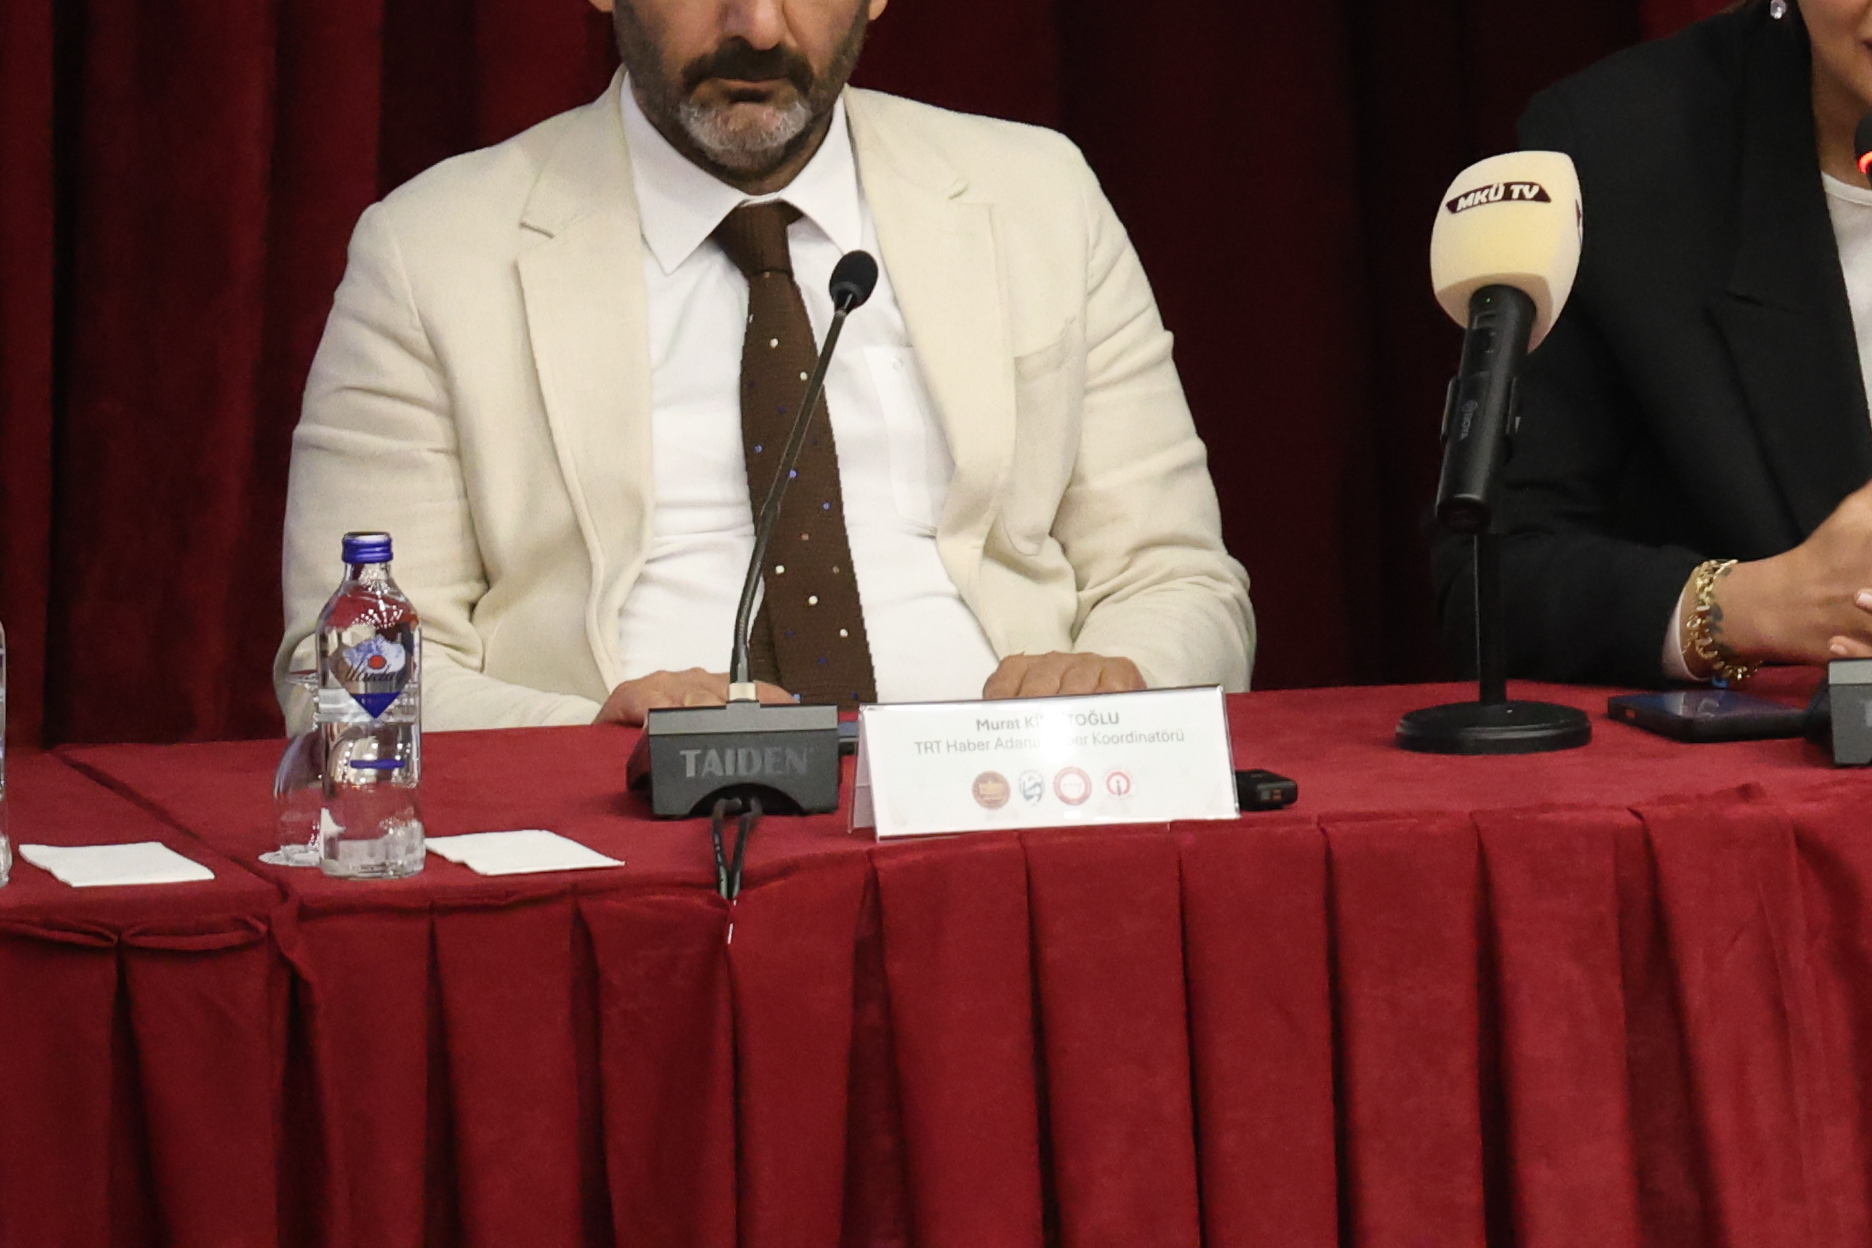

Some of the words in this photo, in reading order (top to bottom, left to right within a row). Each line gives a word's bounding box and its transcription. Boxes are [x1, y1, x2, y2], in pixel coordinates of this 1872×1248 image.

[1456, 183, 1506, 212] MKÜ
[1510, 185, 1540, 199] TV
[976, 717, 1022, 733] Murat
[914, 740, 942, 755] TRT
[946, 737, 990, 753] Haber
[994, 735, 1041, 751] Adana
[1092, 729, 1185, 746] Koordinatörü
[680, 746, 808, 779] TAIDEN
